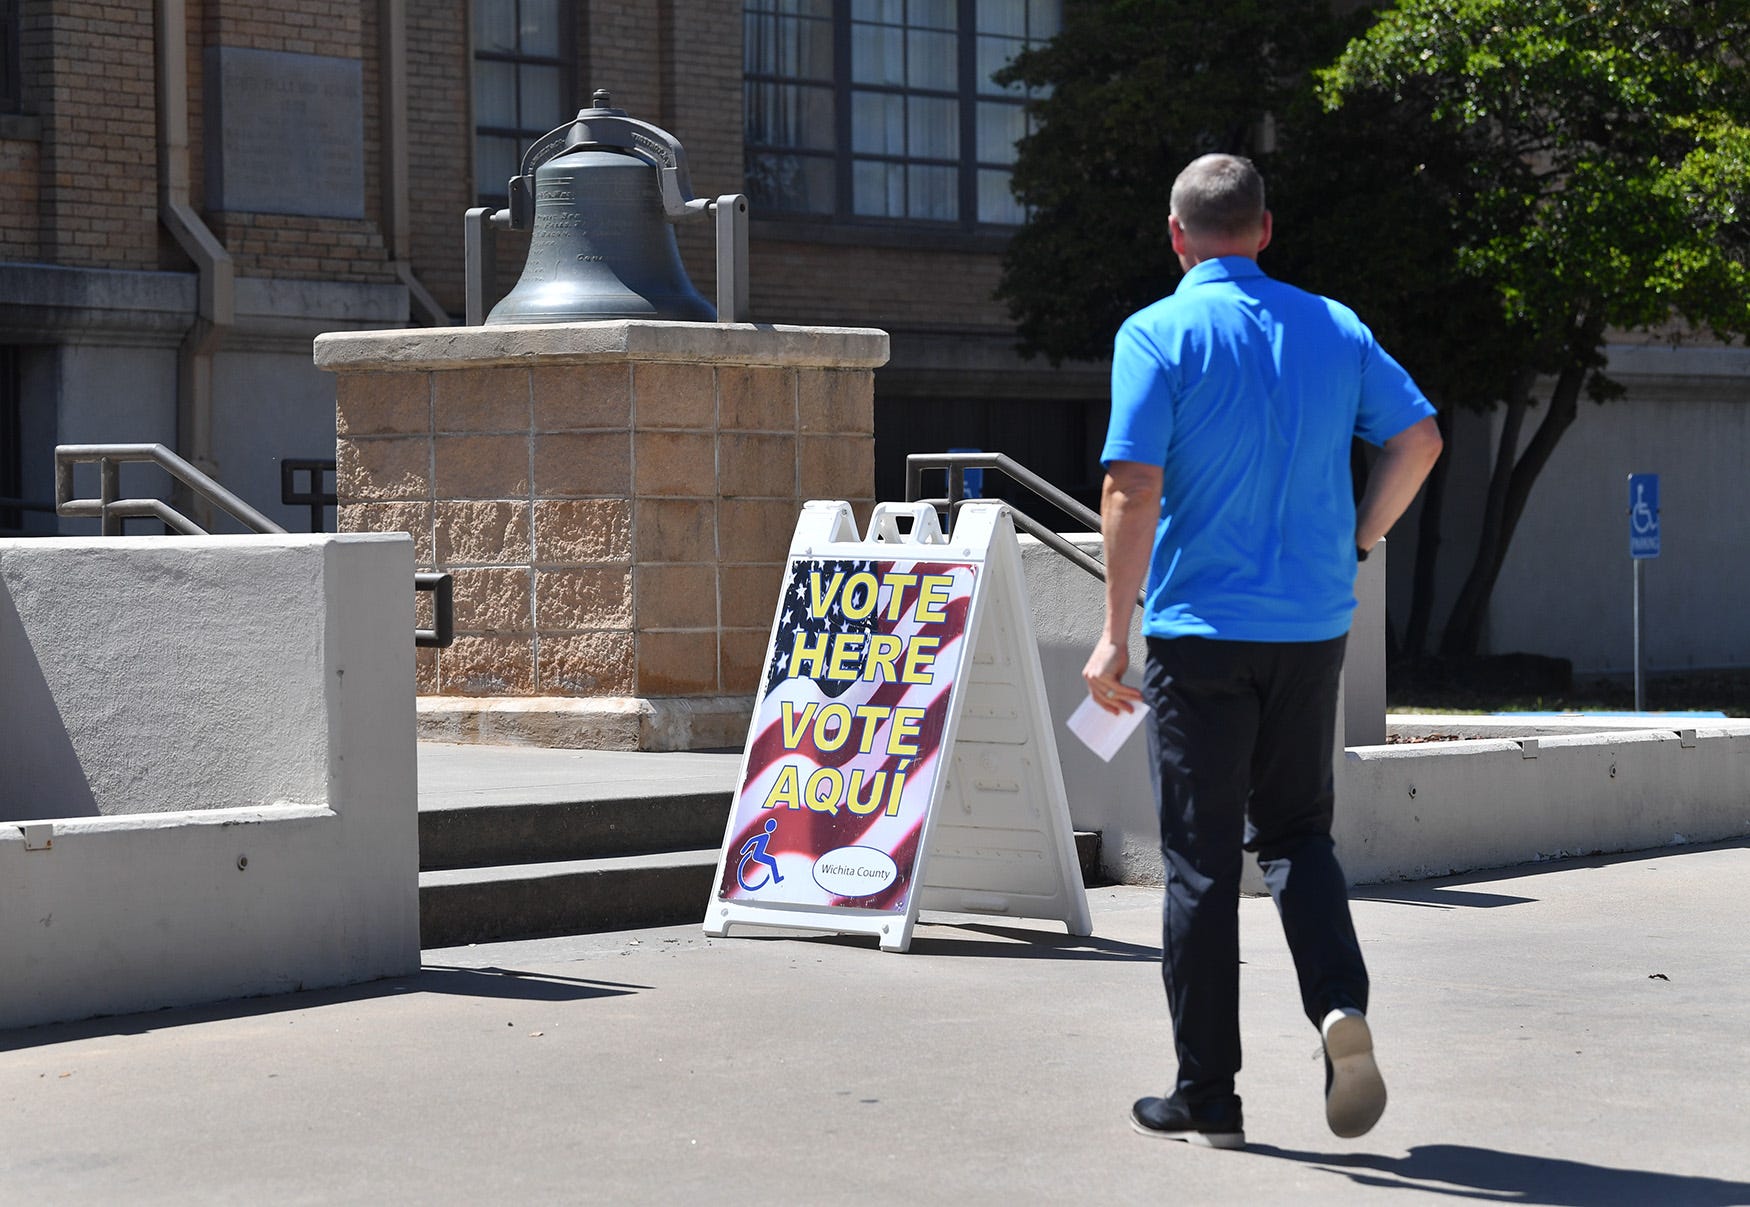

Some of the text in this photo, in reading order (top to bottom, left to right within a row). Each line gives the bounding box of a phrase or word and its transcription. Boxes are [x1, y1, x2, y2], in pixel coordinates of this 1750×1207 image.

[809, 570, 955, 623] VOTE
[787, 631, 942, 685] HERE
[781, 700, 927, 755] VOTE
[762, 757, 912, 817] AQUÍ
[821, 863, 891, 881] Wichita County
